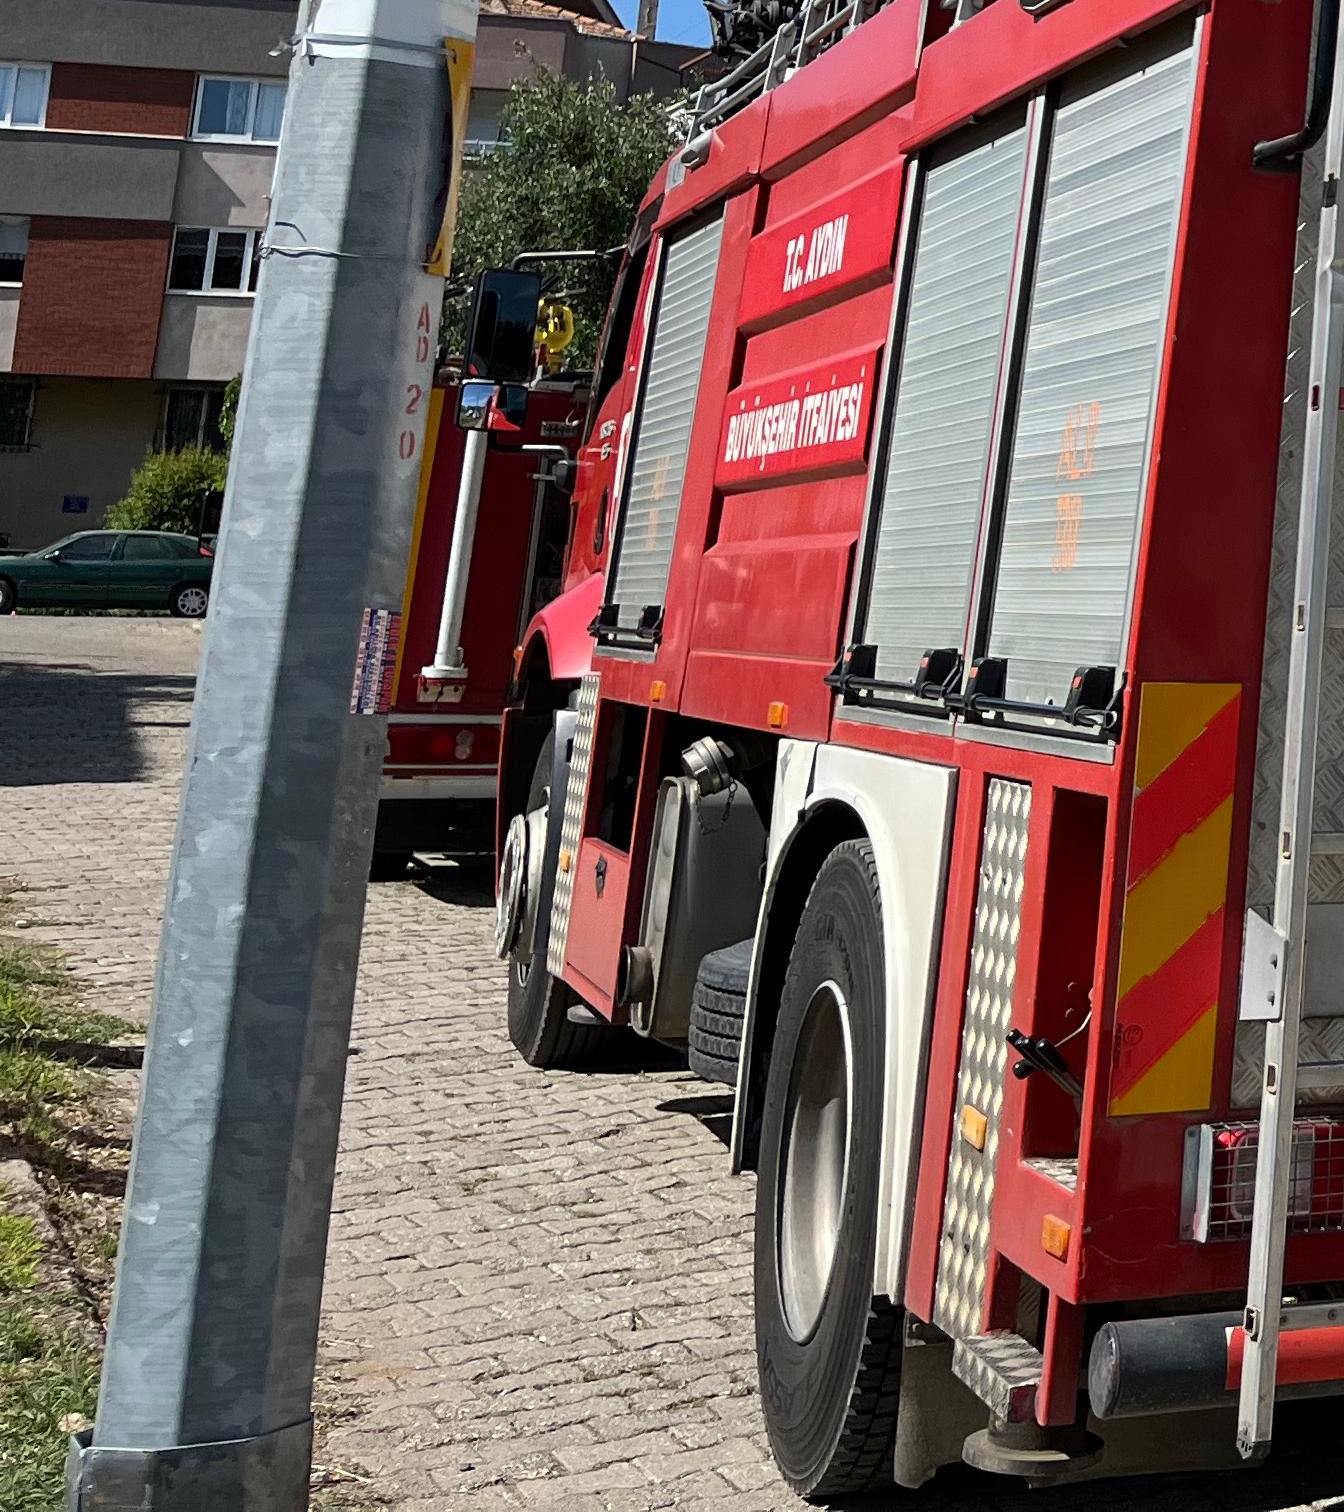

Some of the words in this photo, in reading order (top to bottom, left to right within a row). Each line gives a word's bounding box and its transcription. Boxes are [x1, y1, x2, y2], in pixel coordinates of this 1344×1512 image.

[804, 213, 849, 285] AYDIN
[724, 385, 800, 472] BÜYÜKŞEHİR
[798, 364, 866, 450] İTFAİYESİ
